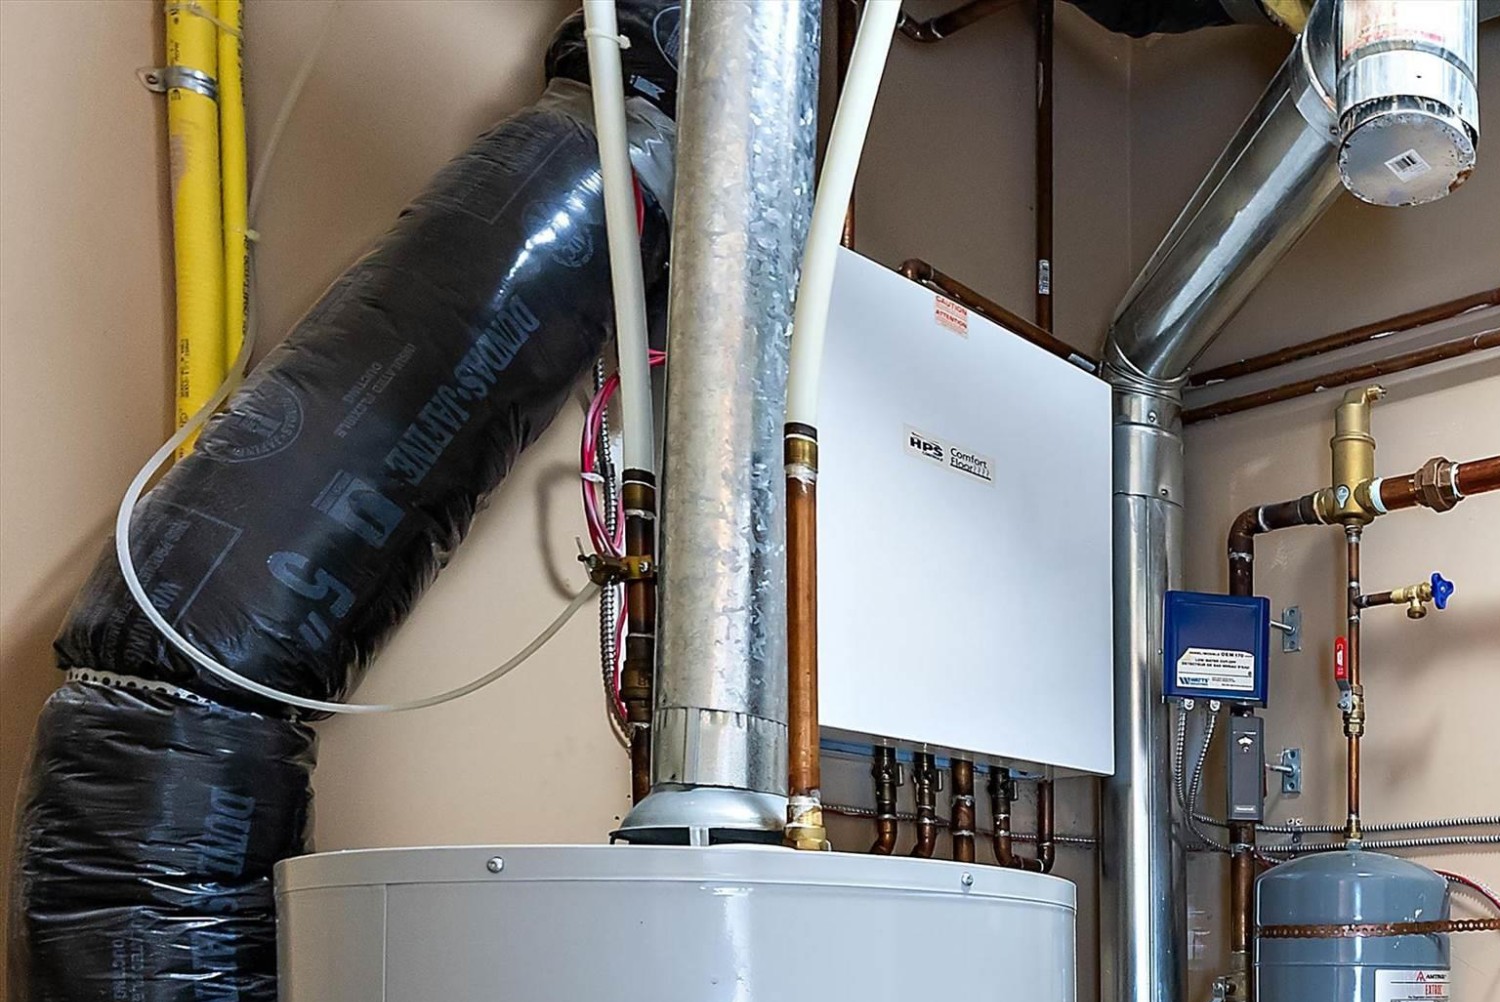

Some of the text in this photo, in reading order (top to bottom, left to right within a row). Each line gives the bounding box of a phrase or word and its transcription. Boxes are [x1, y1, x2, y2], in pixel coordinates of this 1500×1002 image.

[935, 295, 968, 317] CAUTION
[935, 308, 968, 329] ATTENTION
[950, 447, 988, 468] Comfort
